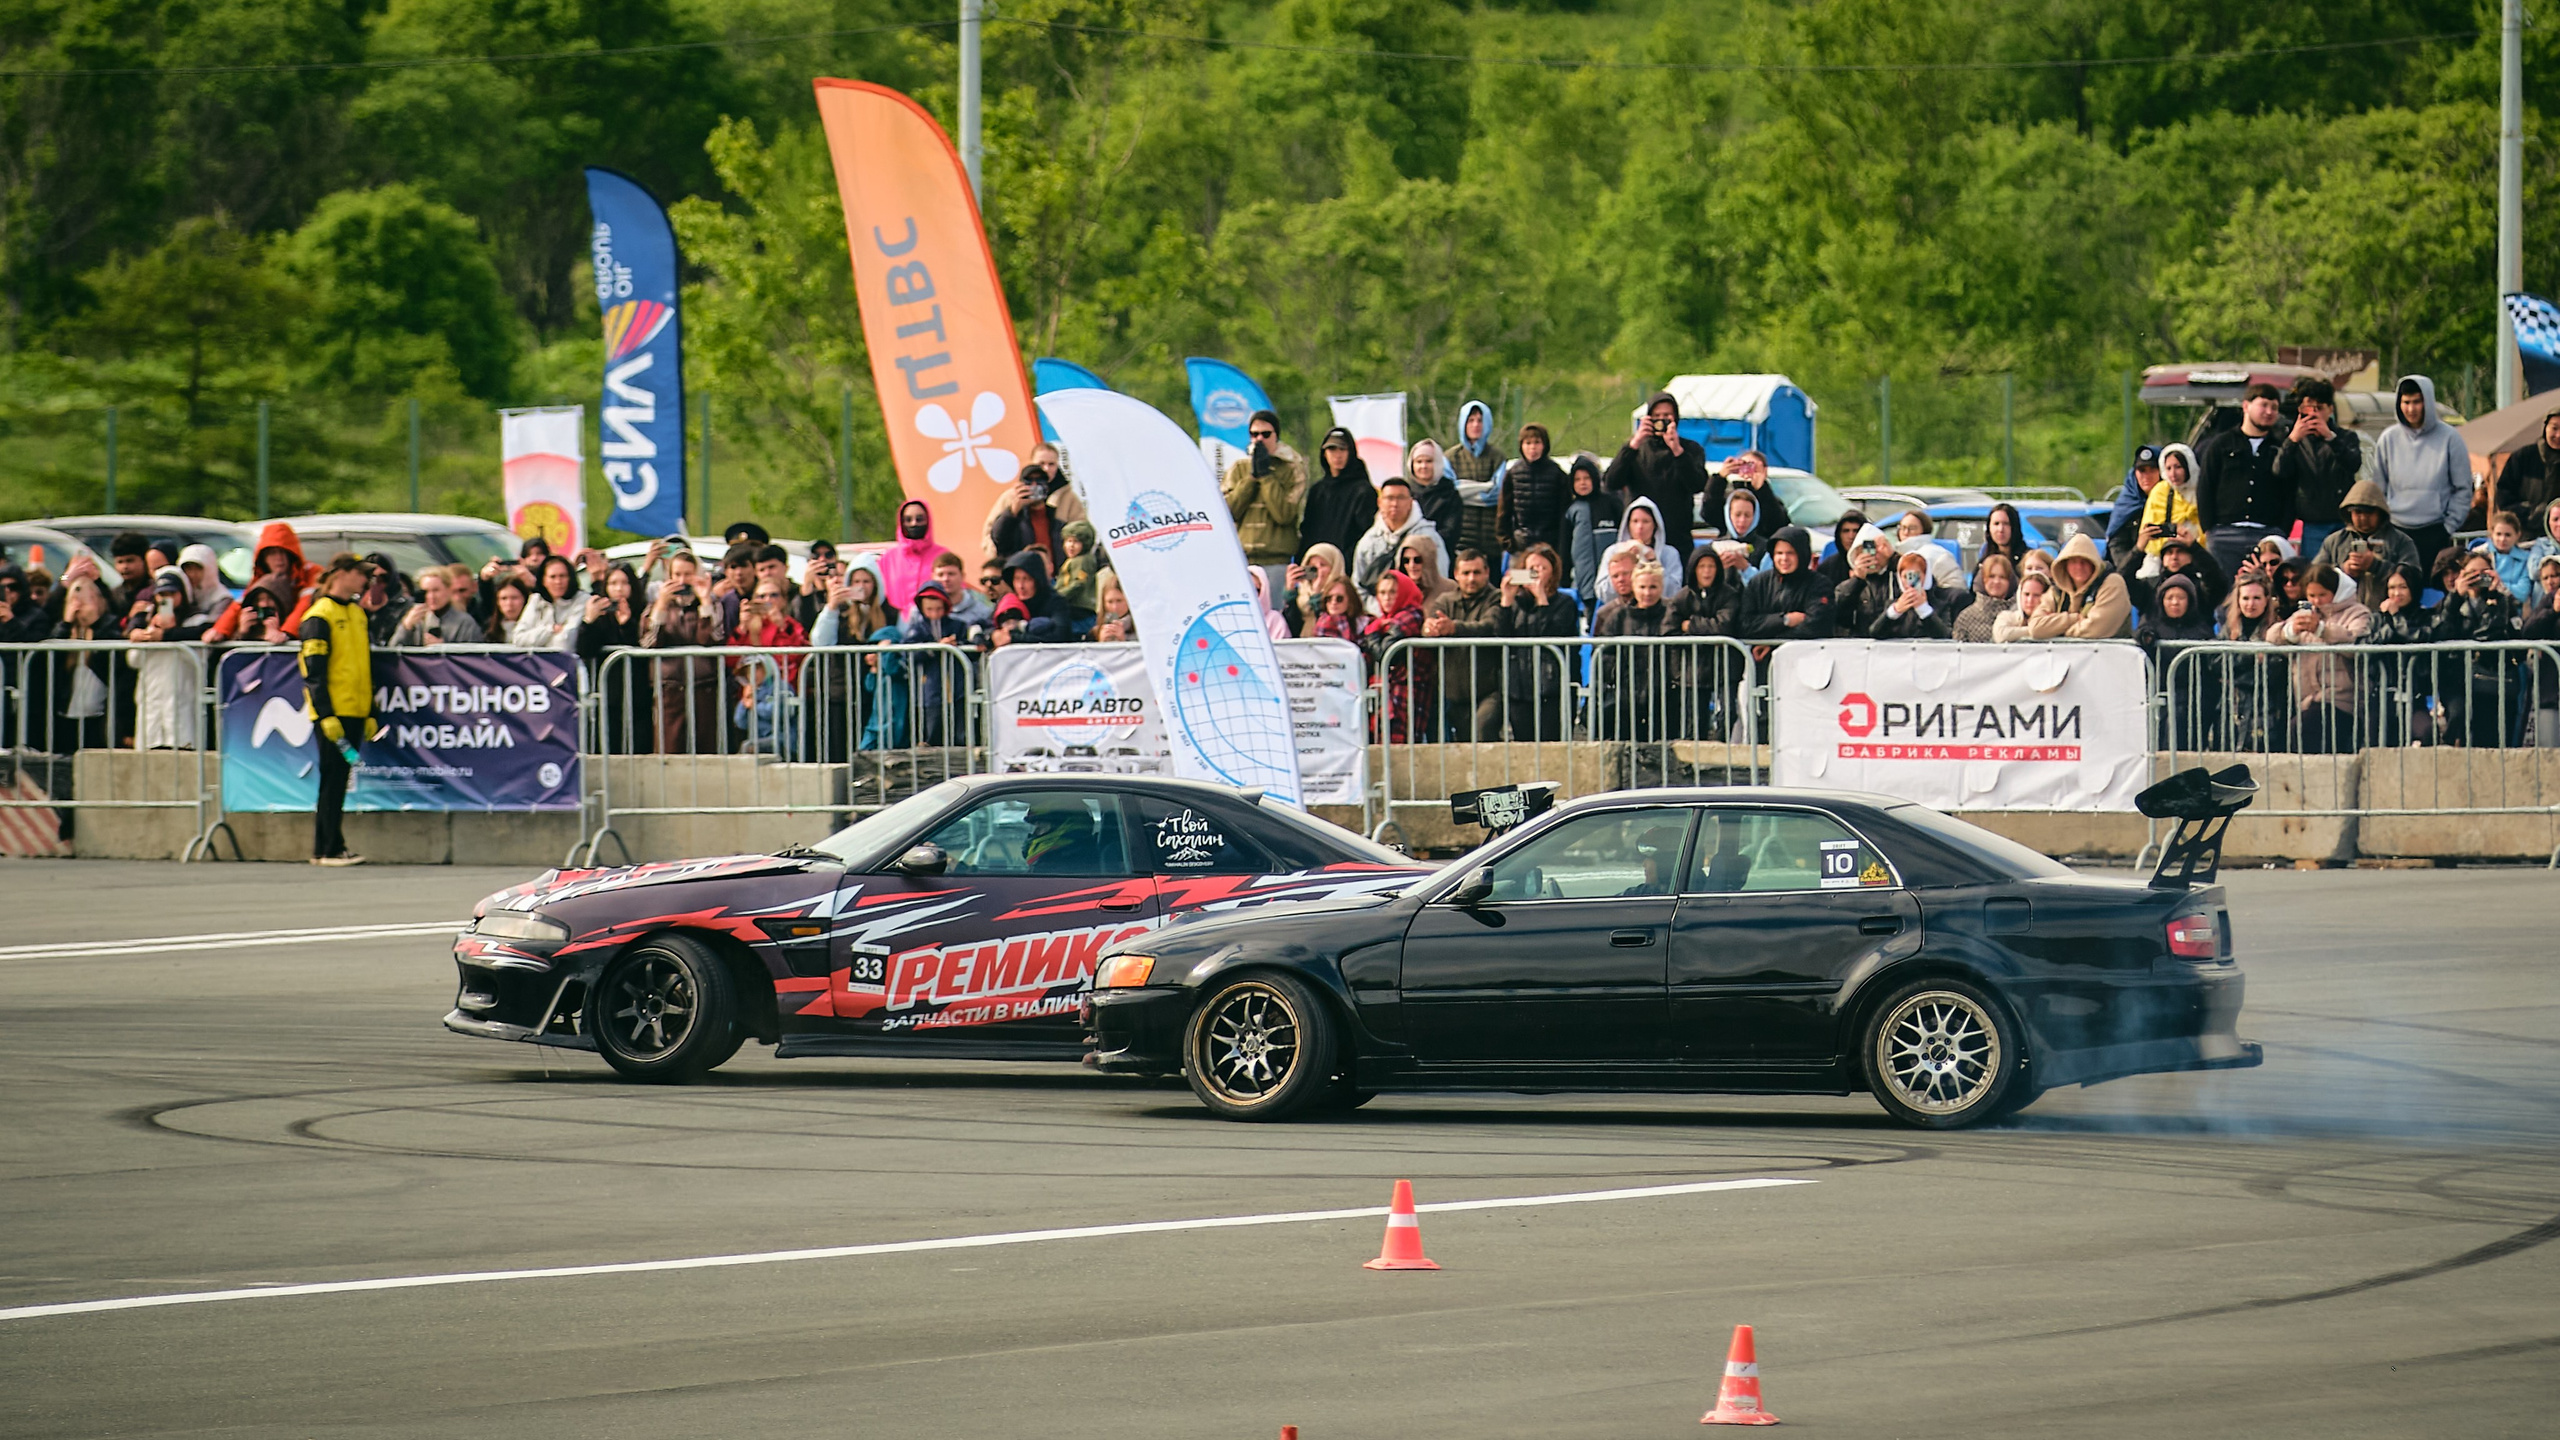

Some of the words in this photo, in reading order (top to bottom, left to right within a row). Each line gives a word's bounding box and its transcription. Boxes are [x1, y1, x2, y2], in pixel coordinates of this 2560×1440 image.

[1017, 699, 1084, 718] РАДАР
[1089, 698, 1144, 714] АВТО
[1838, 692, 2081, 739] ОРИГАМИ
[397, 717, 515, 748] МОБАЙЛ
[1841, 746, 1950, 758] ФАБРИКА
[1968, 747, 2079, 760] РЕКЛАМЫ
[1168, 809, 1209, 833] Твой
[1157, 831, 1225, 849] Сахалин
[1826, 853, 1854, 874] 10
[854, 957, 883, 980] 33
[890, 922, 1152, 1006] РЕМИК
[881, 1006, 986, 1031] ЗАПЧАСТИ
[994, 1003, 1008, 1020] В
[1013, 992, 1084, 1018] НАЛИЧ
